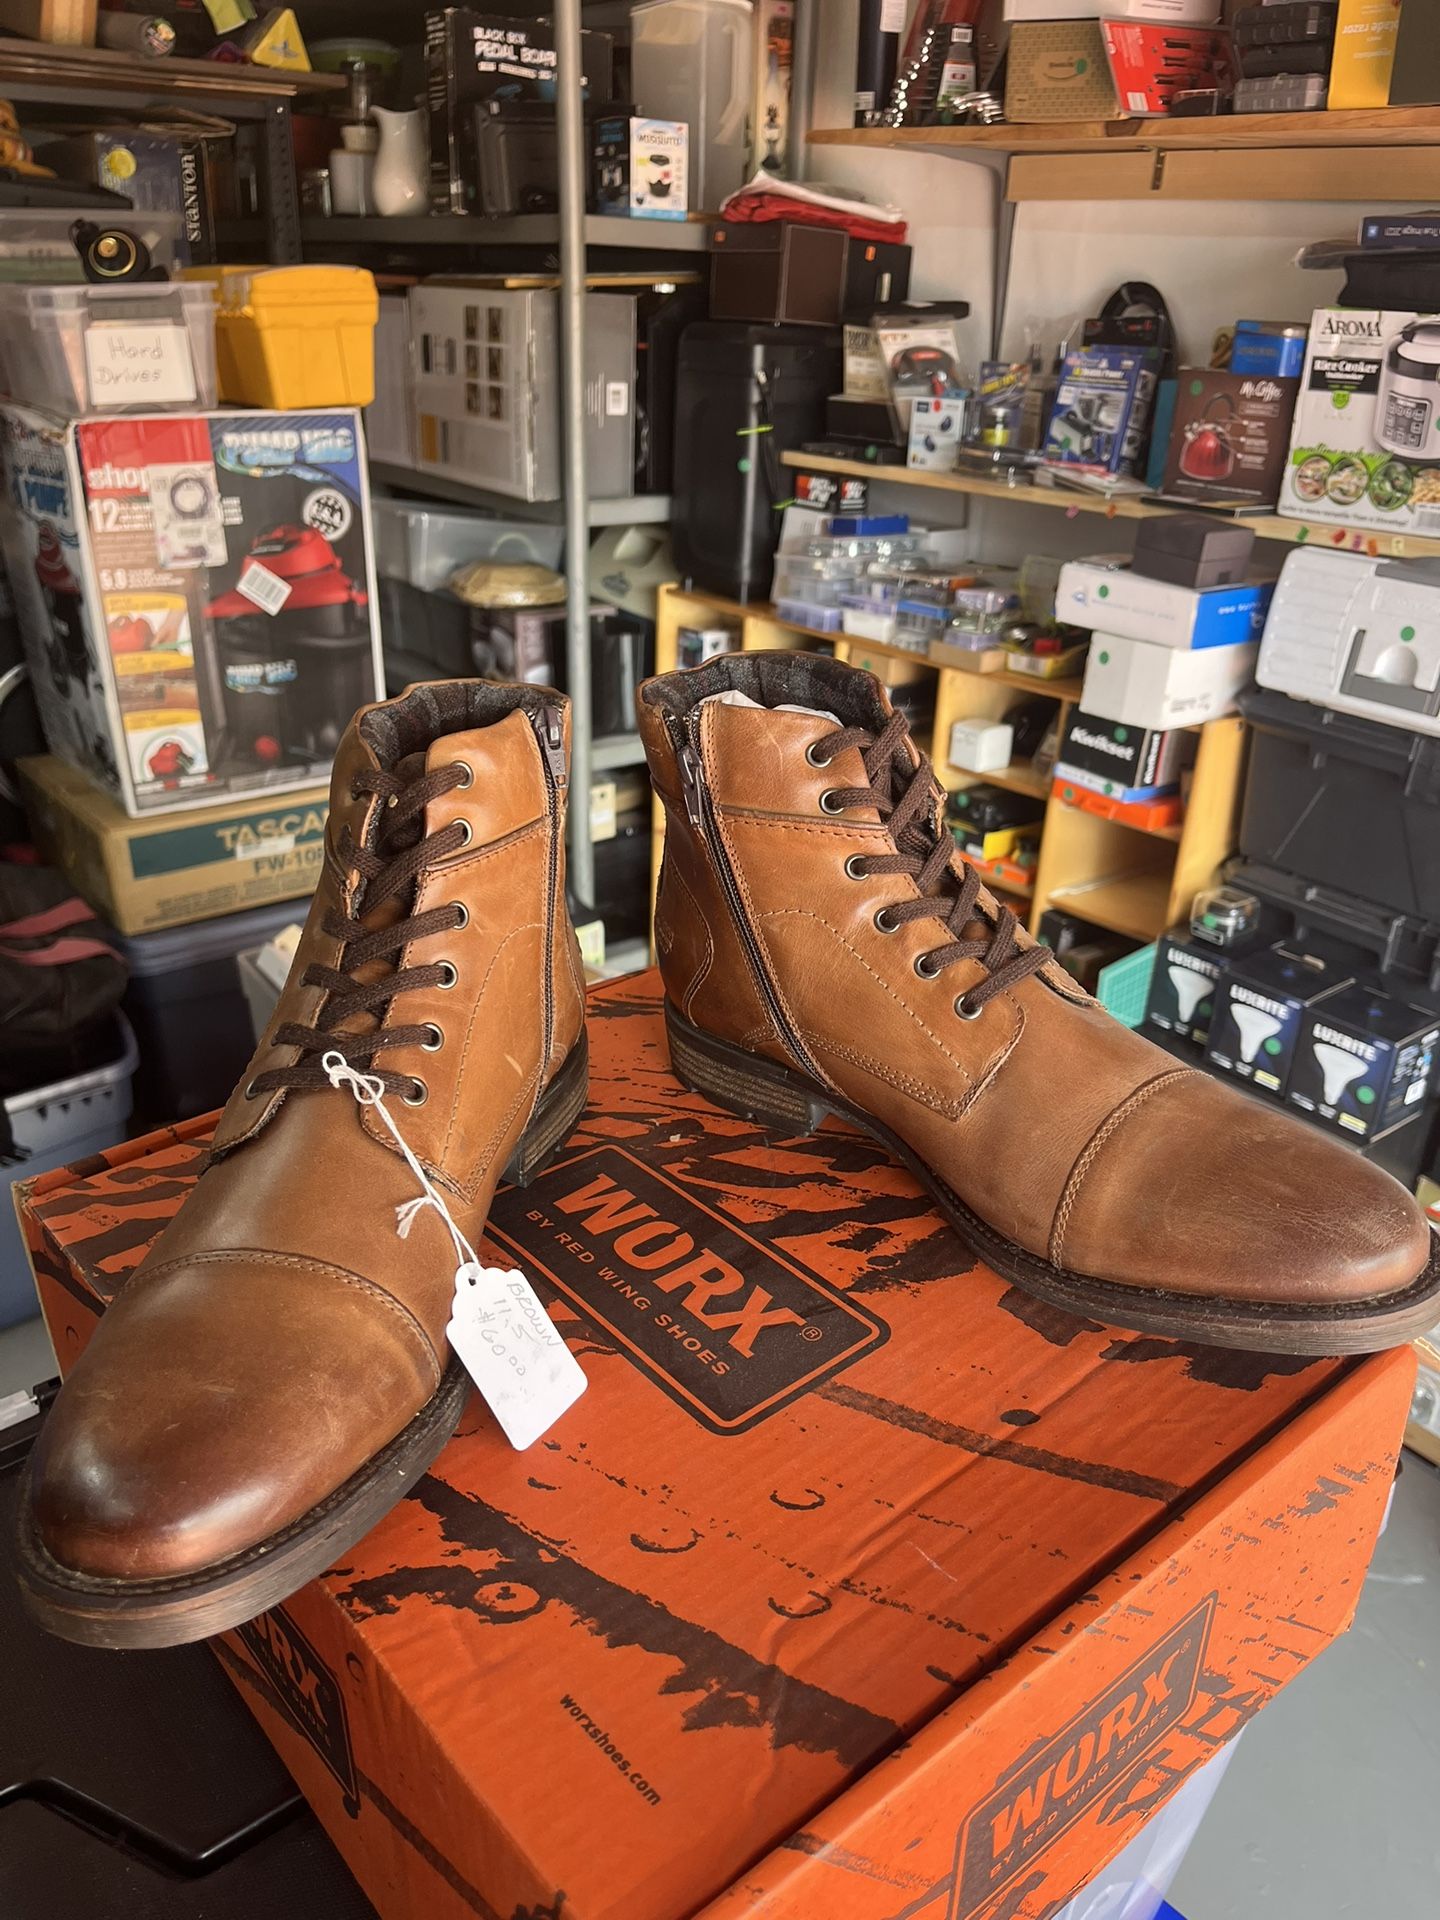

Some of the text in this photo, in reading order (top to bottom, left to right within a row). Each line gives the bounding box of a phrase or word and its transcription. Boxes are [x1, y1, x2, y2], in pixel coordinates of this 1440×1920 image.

[473, 26, 527, 45] BLACK BOX
[475, 41, 558, 68] PEDAL BOAR
[1320, 317, 1382, 338] AROMA
[109, 336, 164, 361] Hard
[94, 366, 163, 386] Drives
[1338, 360, 1379, 375] Cooker
[89, 498, 120, 532] 12
[1070, 725, 1136, 762] Kwikset
[1229, 983, 1291, 1021] LUXRITE
[1312, 1022, 1378, 1063] LUXRITE
[553, 1172, 808, 1360] WORX
[525, 1209, 732, 1376] BY RED WING SHOES
[559, 1693, 662, 1807] worxshoes.com
[990, 1649, 1181, 1859] WORX
[1022, 1810, 1058, 1848] RED
[1065, 1764, 1110, 1807] WING
[1116, 1704, 1170, 1760] SHOES
